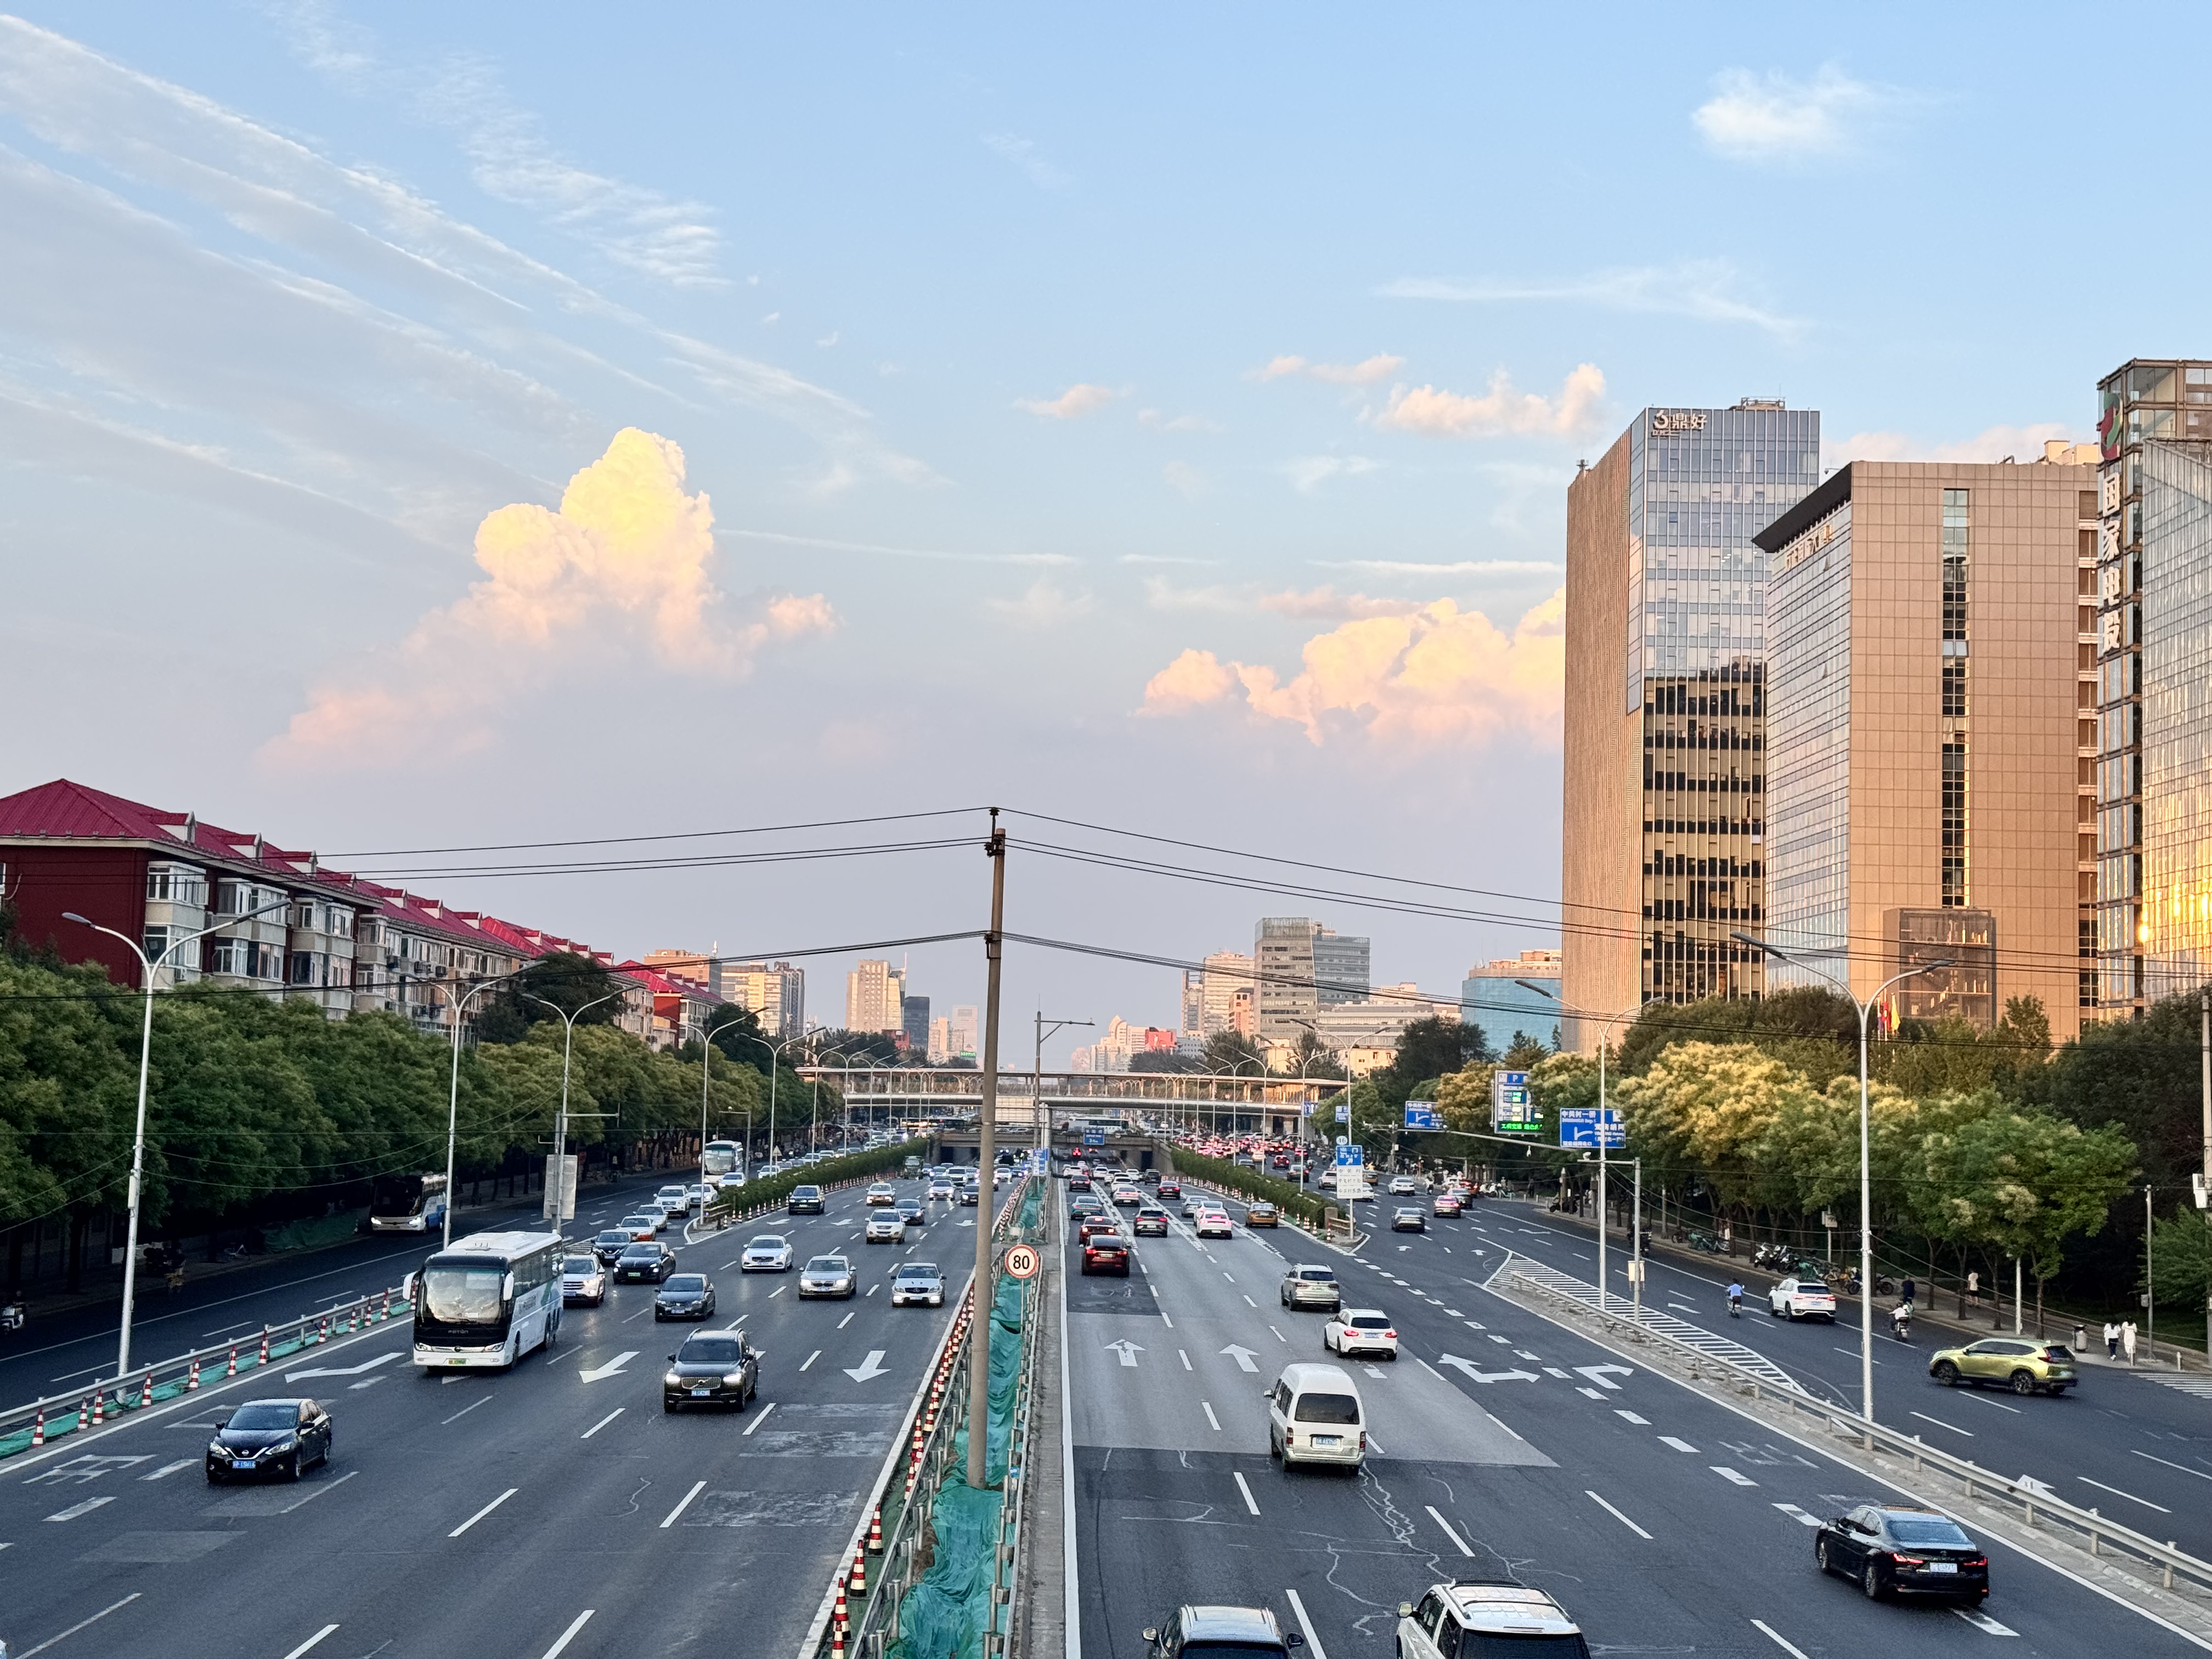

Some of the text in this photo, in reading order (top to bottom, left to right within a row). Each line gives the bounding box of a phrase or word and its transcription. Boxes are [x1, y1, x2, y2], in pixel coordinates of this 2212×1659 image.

[1672, 413, 1707, 430] 鼎好
[2102, 472, 2120, 651] 国家电投
[1013, 1255, 1030, 1269] 80
